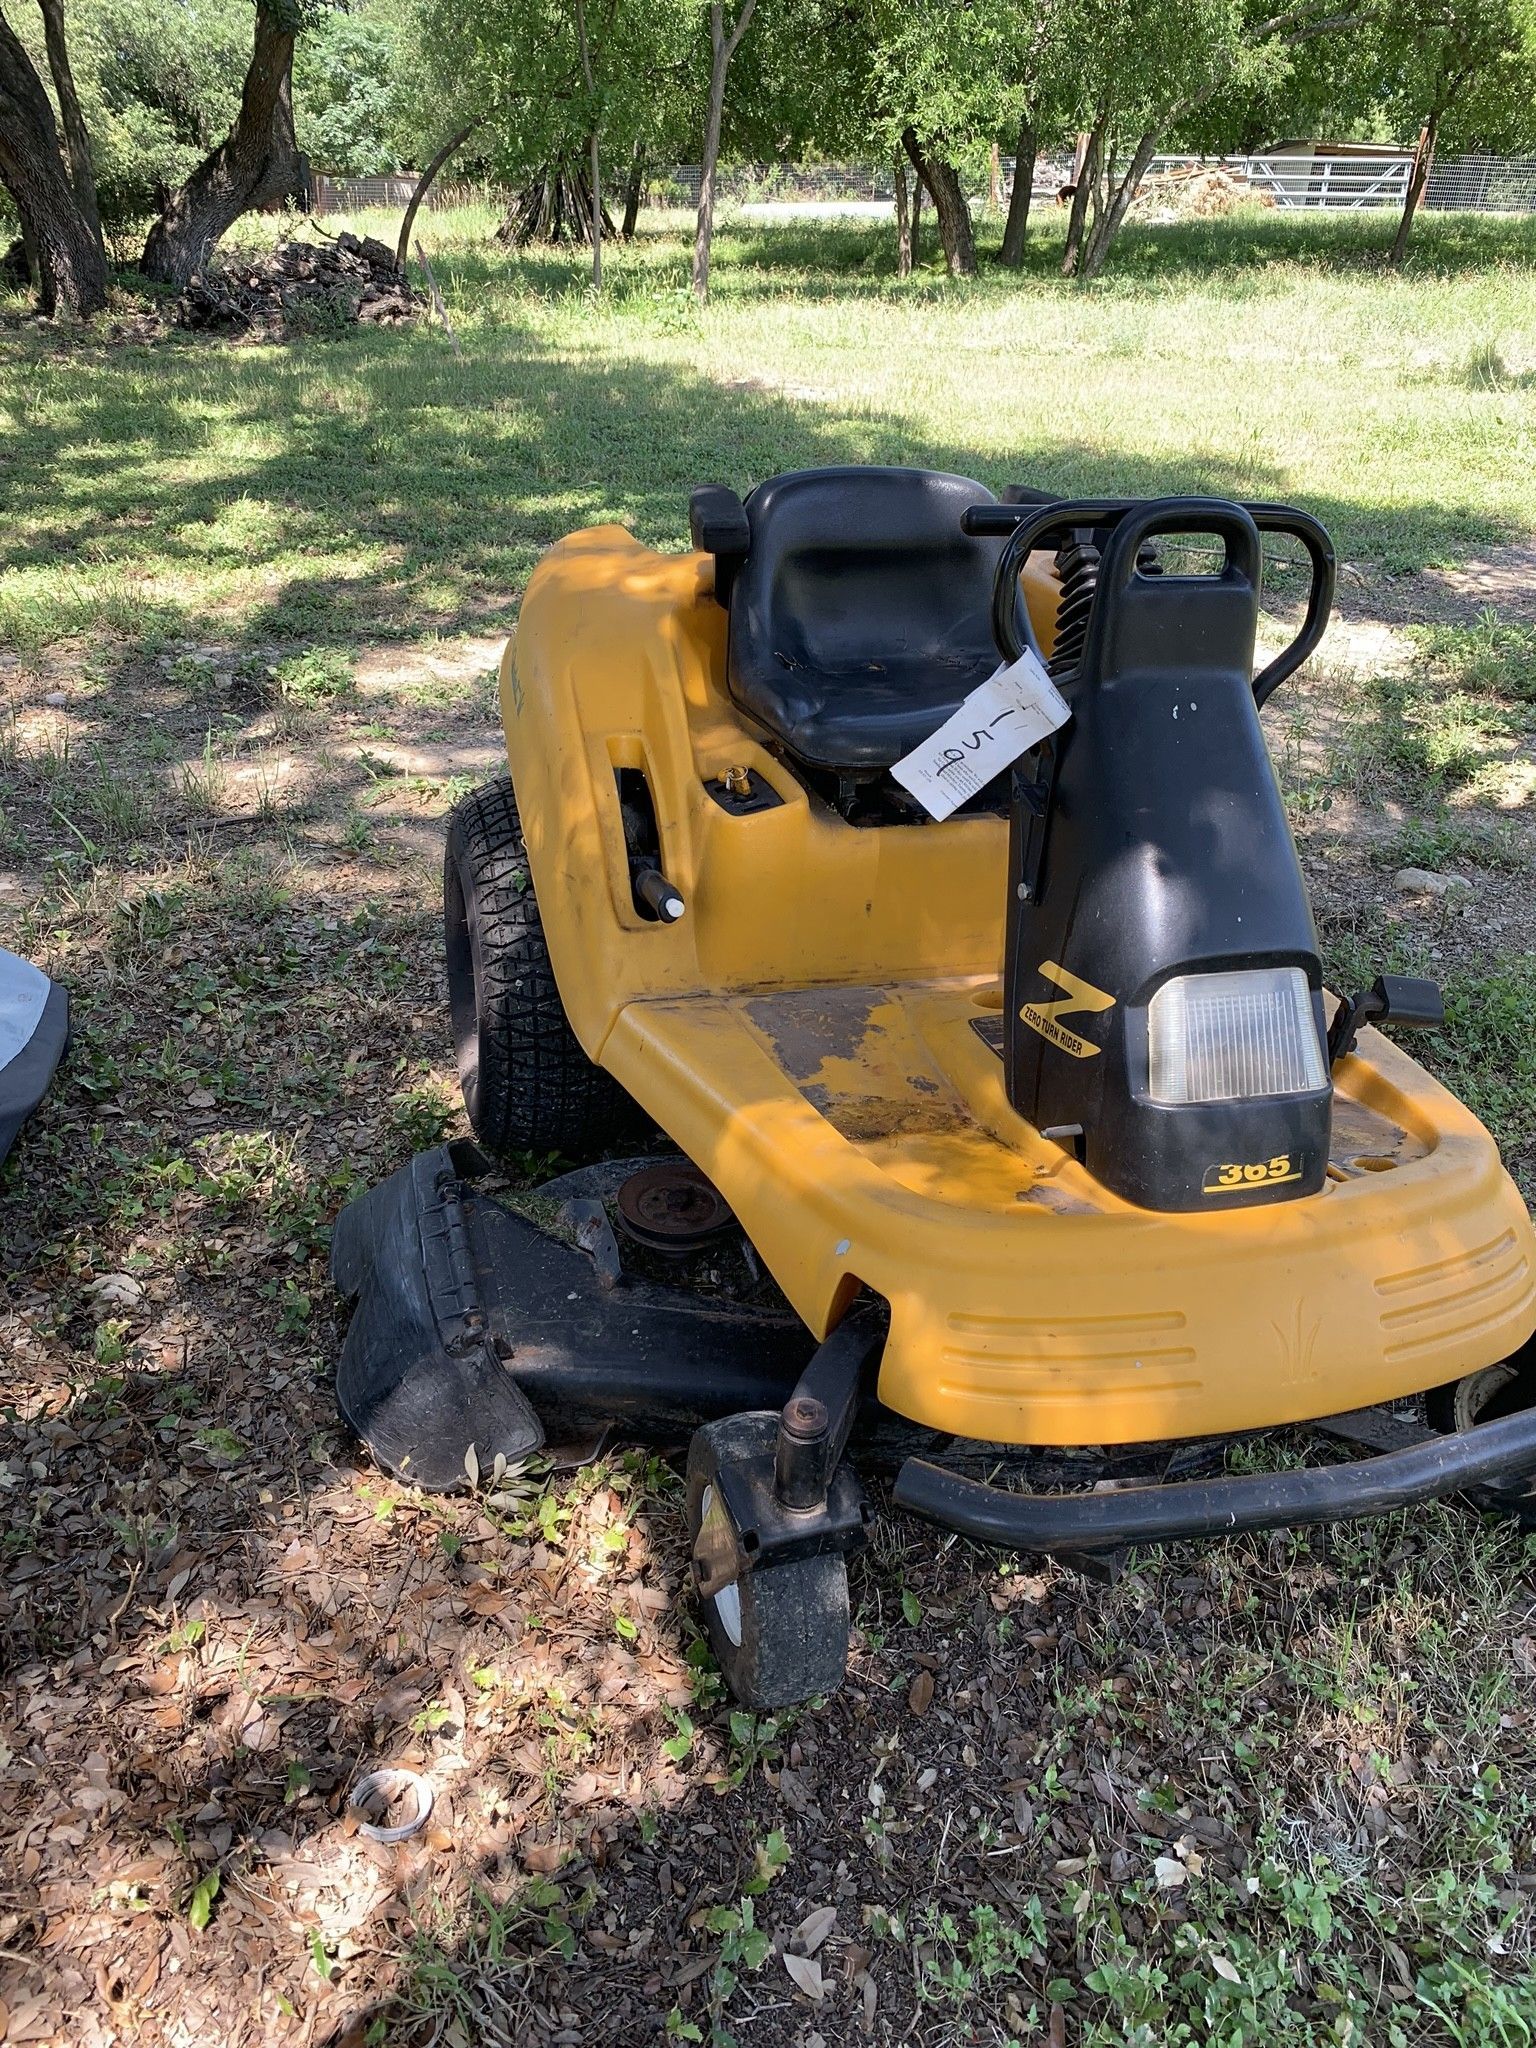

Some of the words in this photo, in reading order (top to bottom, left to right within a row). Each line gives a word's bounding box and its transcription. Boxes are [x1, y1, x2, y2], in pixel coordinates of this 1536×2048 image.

[1024, 1005, 1042, 1028] ZERO
[1041, 1018, 1060, 1041] TURN
[1059, 1031, 1083, 1056] RIDER
[1218, 1154, 1291, 1186] 365
